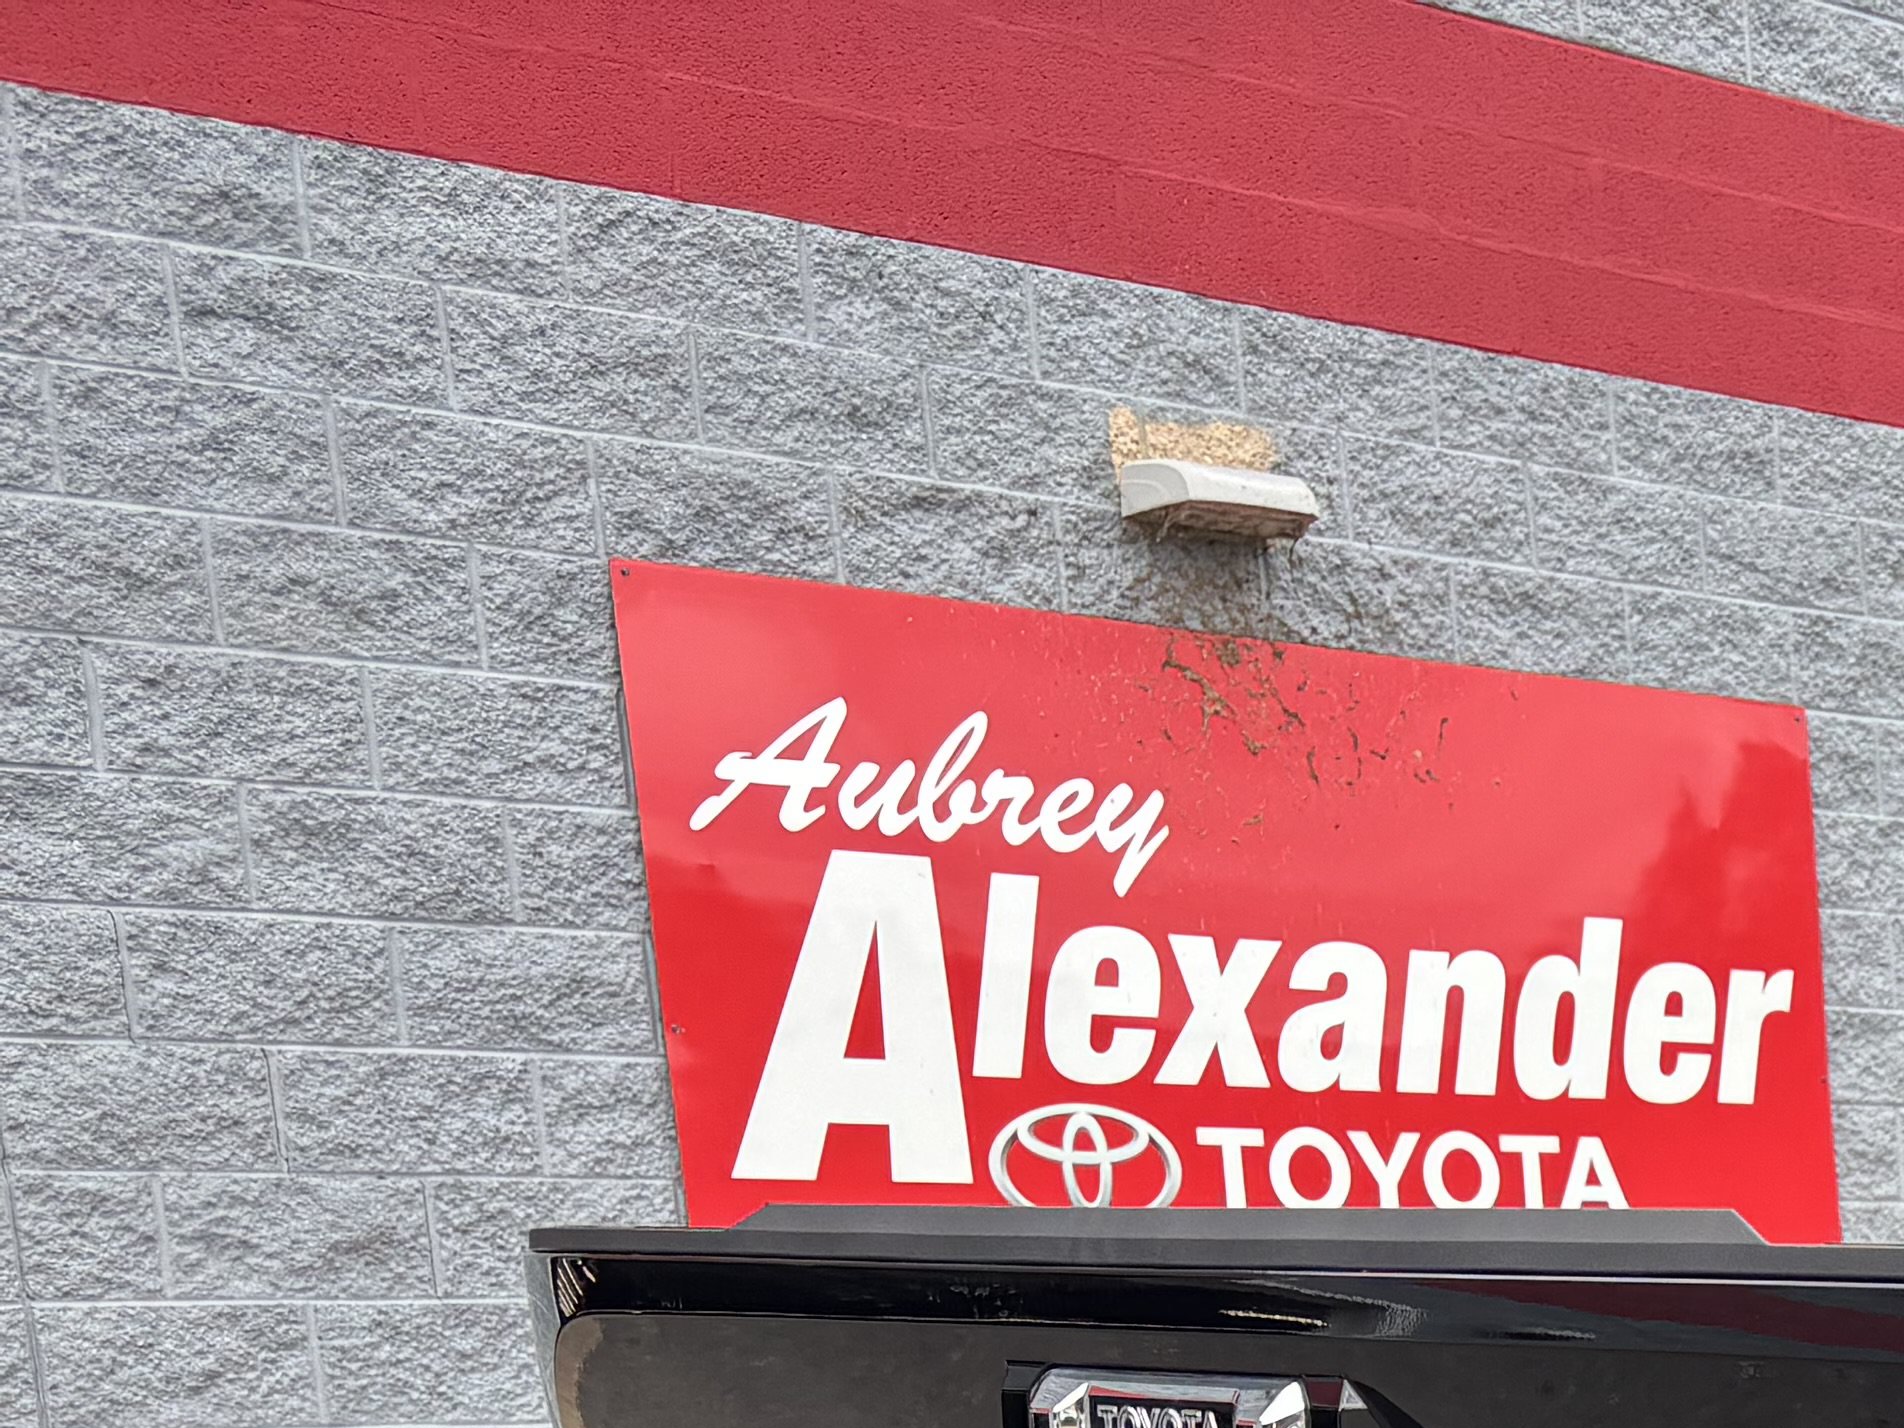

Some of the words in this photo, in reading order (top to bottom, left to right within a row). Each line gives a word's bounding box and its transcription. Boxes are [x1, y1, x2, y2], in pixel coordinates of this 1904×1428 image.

[688, 696, 1171, 897] Aubrey
[730, 848, 1795, 1186] Alexander
[1195, 1124, 1631, 1211] TOYOTA
